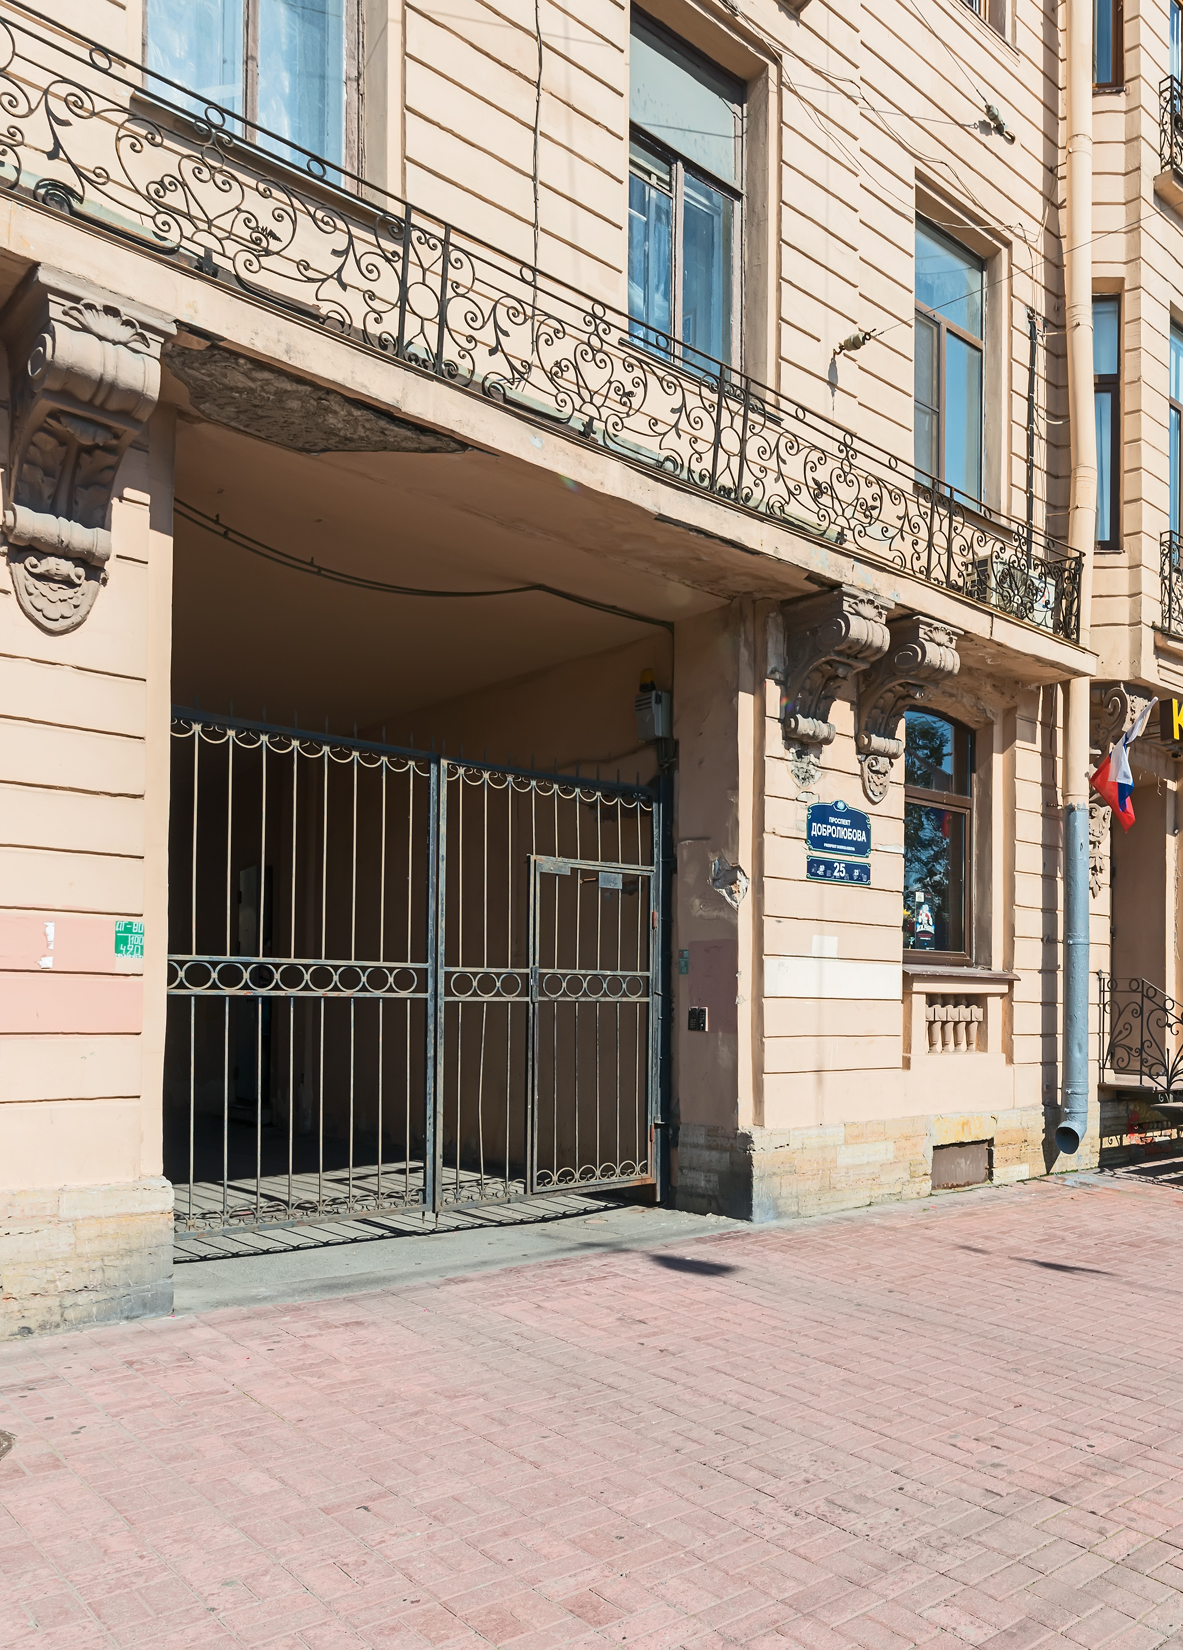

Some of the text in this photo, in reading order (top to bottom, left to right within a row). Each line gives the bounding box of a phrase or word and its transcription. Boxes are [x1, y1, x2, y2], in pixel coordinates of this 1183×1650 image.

[829, 817, 851, 826] ПРОСПЕКТ
[811, 823, 866, 842] ДОБРОЛЮБОВА
[834, 863, 845, 877] 25
